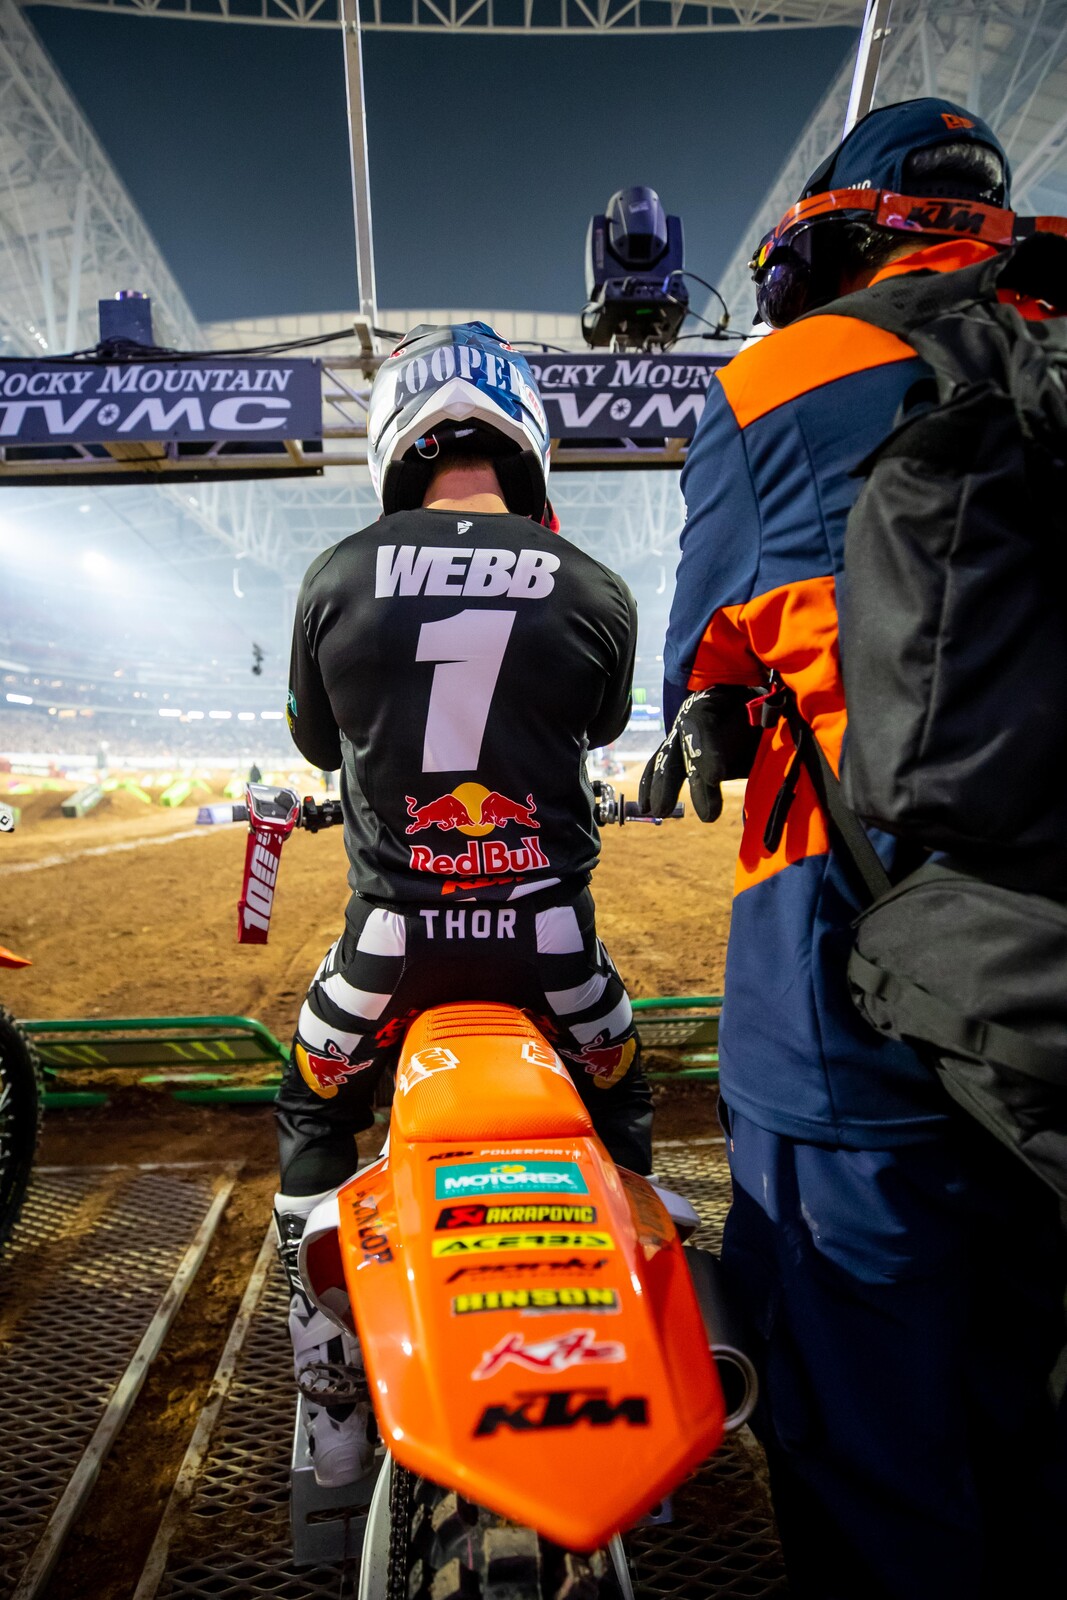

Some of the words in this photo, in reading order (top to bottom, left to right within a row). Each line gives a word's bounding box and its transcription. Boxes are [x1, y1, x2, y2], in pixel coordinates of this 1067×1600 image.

[904, 202, 986, 235] KTM
[0, 369, 94, 397] OCKY
[96, 364, 293, 394] MOUNTAIN
[607, 359, 722, 389] MOUN
[374, 544, 561, 599] WEBB
[415, 608, 517, 773] 1
[409, 840, 481, 875] Red
[482, 835, 550, 875] Bull
[419, 908, 517, 939] THOR
[444, 1172, 574, 1190] MOTOREX
[456, 1287, 614, 1313] HINSON
[471, 1387, 650, 1440] KTM
